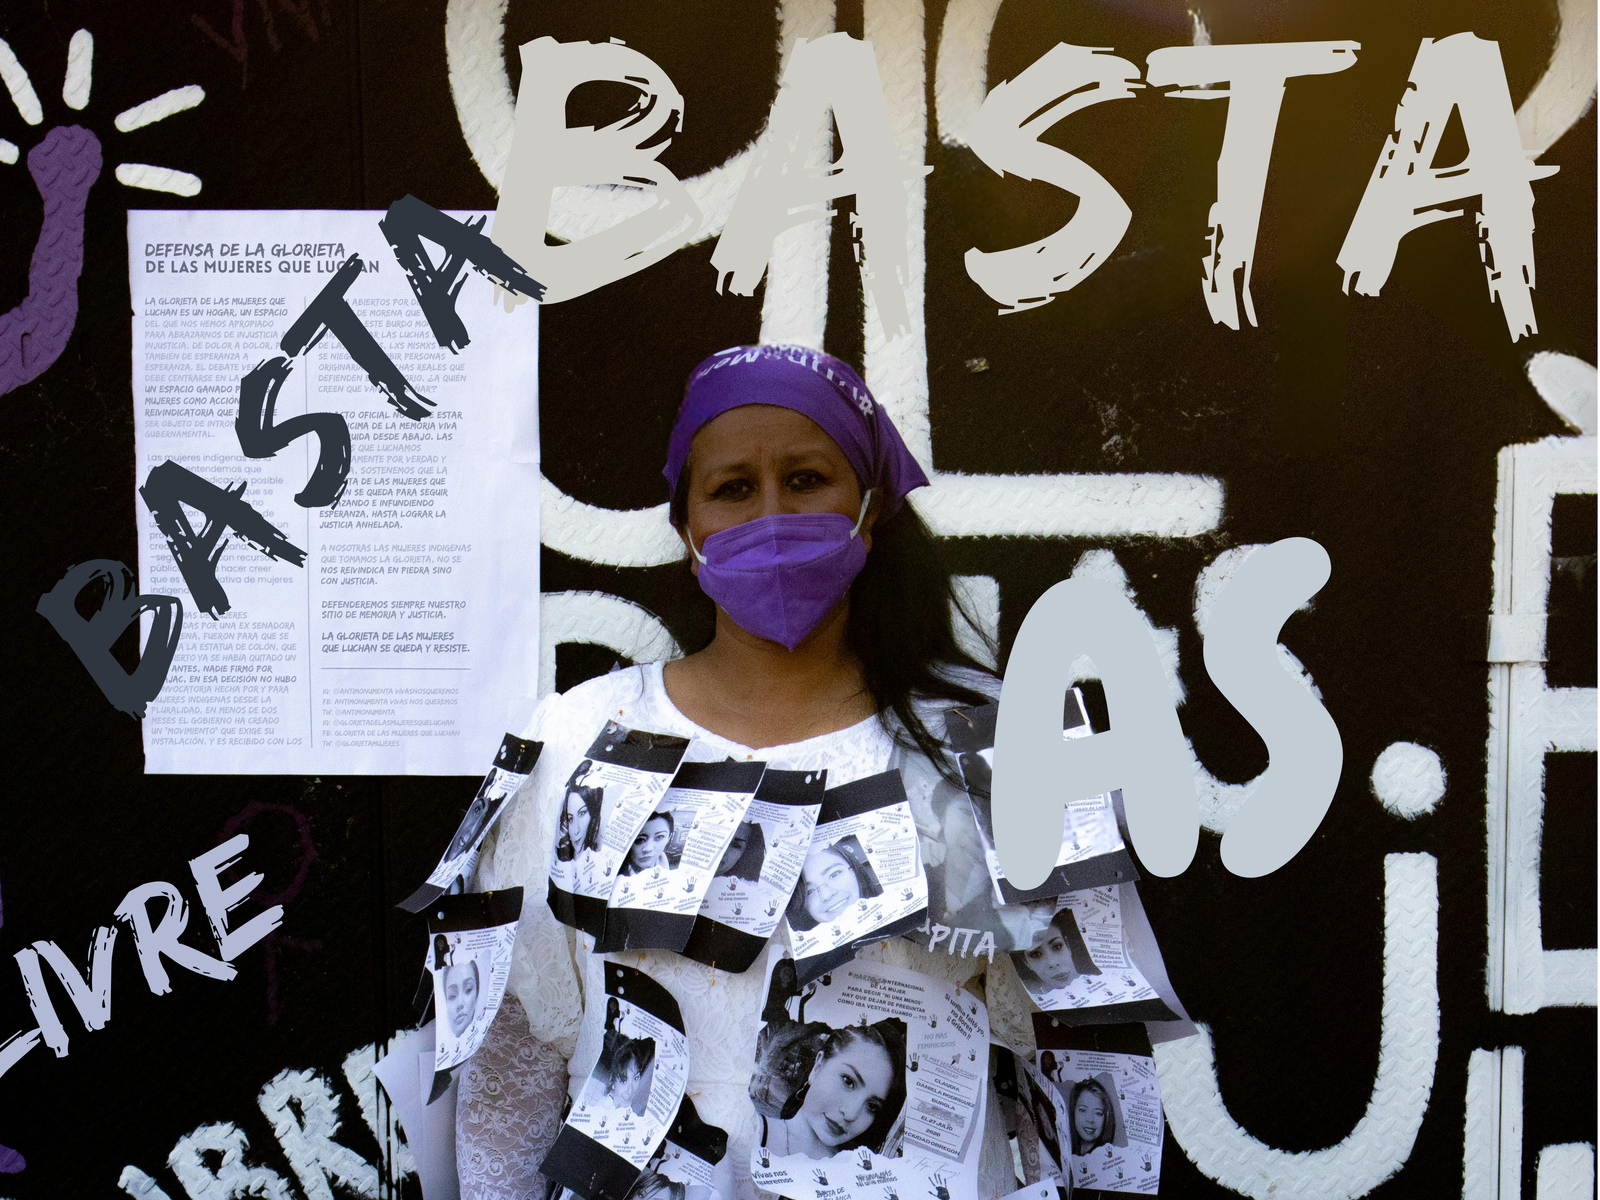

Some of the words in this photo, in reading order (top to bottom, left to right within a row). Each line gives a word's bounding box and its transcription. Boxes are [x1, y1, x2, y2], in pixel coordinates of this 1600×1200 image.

[145, 242, 214, 259] DEFENSA
[220, 242, 240, 259] DE
[245, 242, 264, 259] LA
[271, 242, 346, 259] GLORIETA
[146, 260, 164, 275] DE
[172, 260, 198, 275] LAS
[204, 260, 272, 275] MUJERES
[278, 260, 310, 275] QUE
[317, 260, 380, 274] LUCAN
[145, 296, 156, 307] LA
[158, 296, 197, 307] GLORIETA
[200, 296, 211, 307] DE
[214, 296, 229, 307] LAS
[232, 296, 267, 307] MUJERES
[269, 296, 285, 307] QUE
[145, 307, 178, 318] LUCHAN
[180, 307, 190, 318] ES
[192, 307, 204, 318] UN
[240, 307, 252, 318] UN
[254, 307, 288, 318] ESPACIO
[145, 384, 156, 394] UN
[159, 384, 194, 394] ESPACIO
[196, 384, 233, 394] GANADO
[145, 396, 180, 406] MUJERES
[184, 396, 206, 406] COMO
[210, 395, 240, 406] ACCIÓN
[145, 408, 214, 418] REIVINDICATORIA
[217, 408, 233, 418] QUE
[372, 511, 397, 520] HASTA
[400, 511, 433, 520] LOGRAR
[436, 511, 446, 520] LA
[320, 521, 353, 530] JUSTICIA
[356, 521, 402, 530] ANHELADA.
[321, 566, 338, 575] NOS
[340, 566, 384, 575] REIVINDICA
[388, 566, 399, 575] EN
[401, 566, 429, 575] PIEDRA
[433, 566, 452, 575] SINO
[321, 577, 338, 586] CON
[341, 577, 377, 586] JUSTICIA.
[322, 600, 388, 610] DEFENDEREMOS
[391, 600, 425, 610] SIEMPRE
[428, 600, 466, 610] NUESTRO
[322, 610, 343, 620] SITIO
[346, 610, 356, 620] DE
[359, 610, 396, 620] MEMORIA
[400, 610, 405, 620] Y
[408, 610, 446, 620] JUSTICIA.
[322, 632, 333, 642] LA
[337, 632, 379, 642] GLORIETA
[382, 632, 394, 642] DE
[396, 632, 413, 642] LAS
[416, 632, 454, 642] MUJERES
[322, 644, 339, 654] QUE
[342, 644, 377, 654] LUCHAN
[380, 644, 390, 654] SE
[393, 644, 422, 654] QUEDA
[426, 644, 431, 654] Y
[434, 644, 470, 654] RESISTE.
[864, 989, 881, 997] DECIR
[888, 986, 906, 995] MUJER
[868, 997, 886, 1005] DEJAR
[867, 1004, 890, 1013] VESTIDA
[891, 1008, 912, 1018] CUANDO
[916, 1081, 942, 1096] DANIELA
[934, 1078, 960, 1092] CLAUDIA
[926, 1128, 941, 1137] 2020
